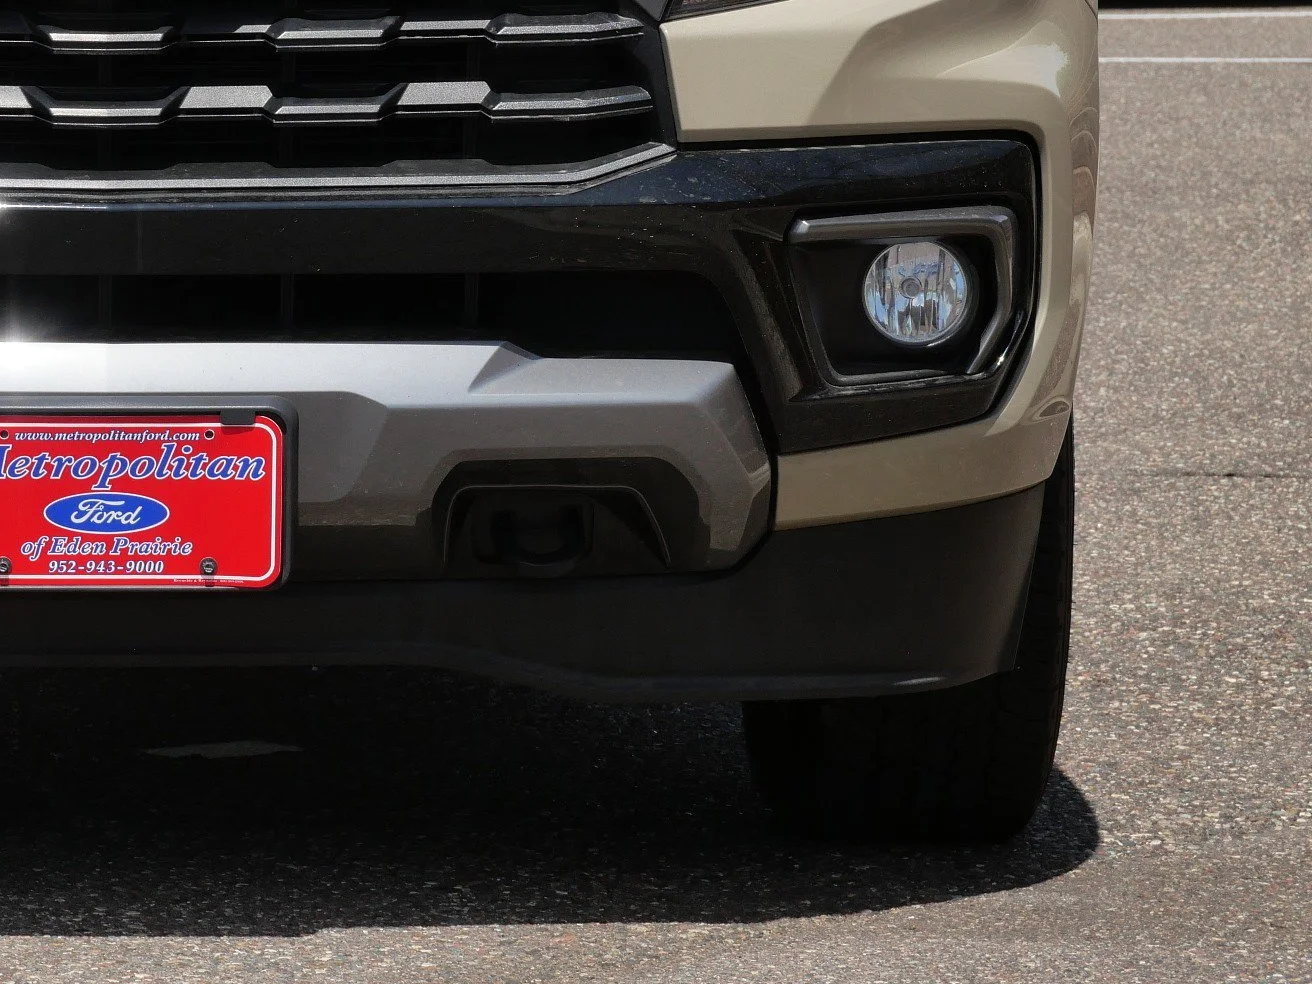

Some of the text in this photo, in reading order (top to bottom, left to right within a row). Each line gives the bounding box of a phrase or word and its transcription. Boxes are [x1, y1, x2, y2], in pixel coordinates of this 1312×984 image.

[14, 429, 200, 444] www.metropolitanford.com
[70, 498, 142, 526] Ford
[20, 536, 194, 561] of Eden Prairie
[48, 560, 165, 574] 952-943-9000
